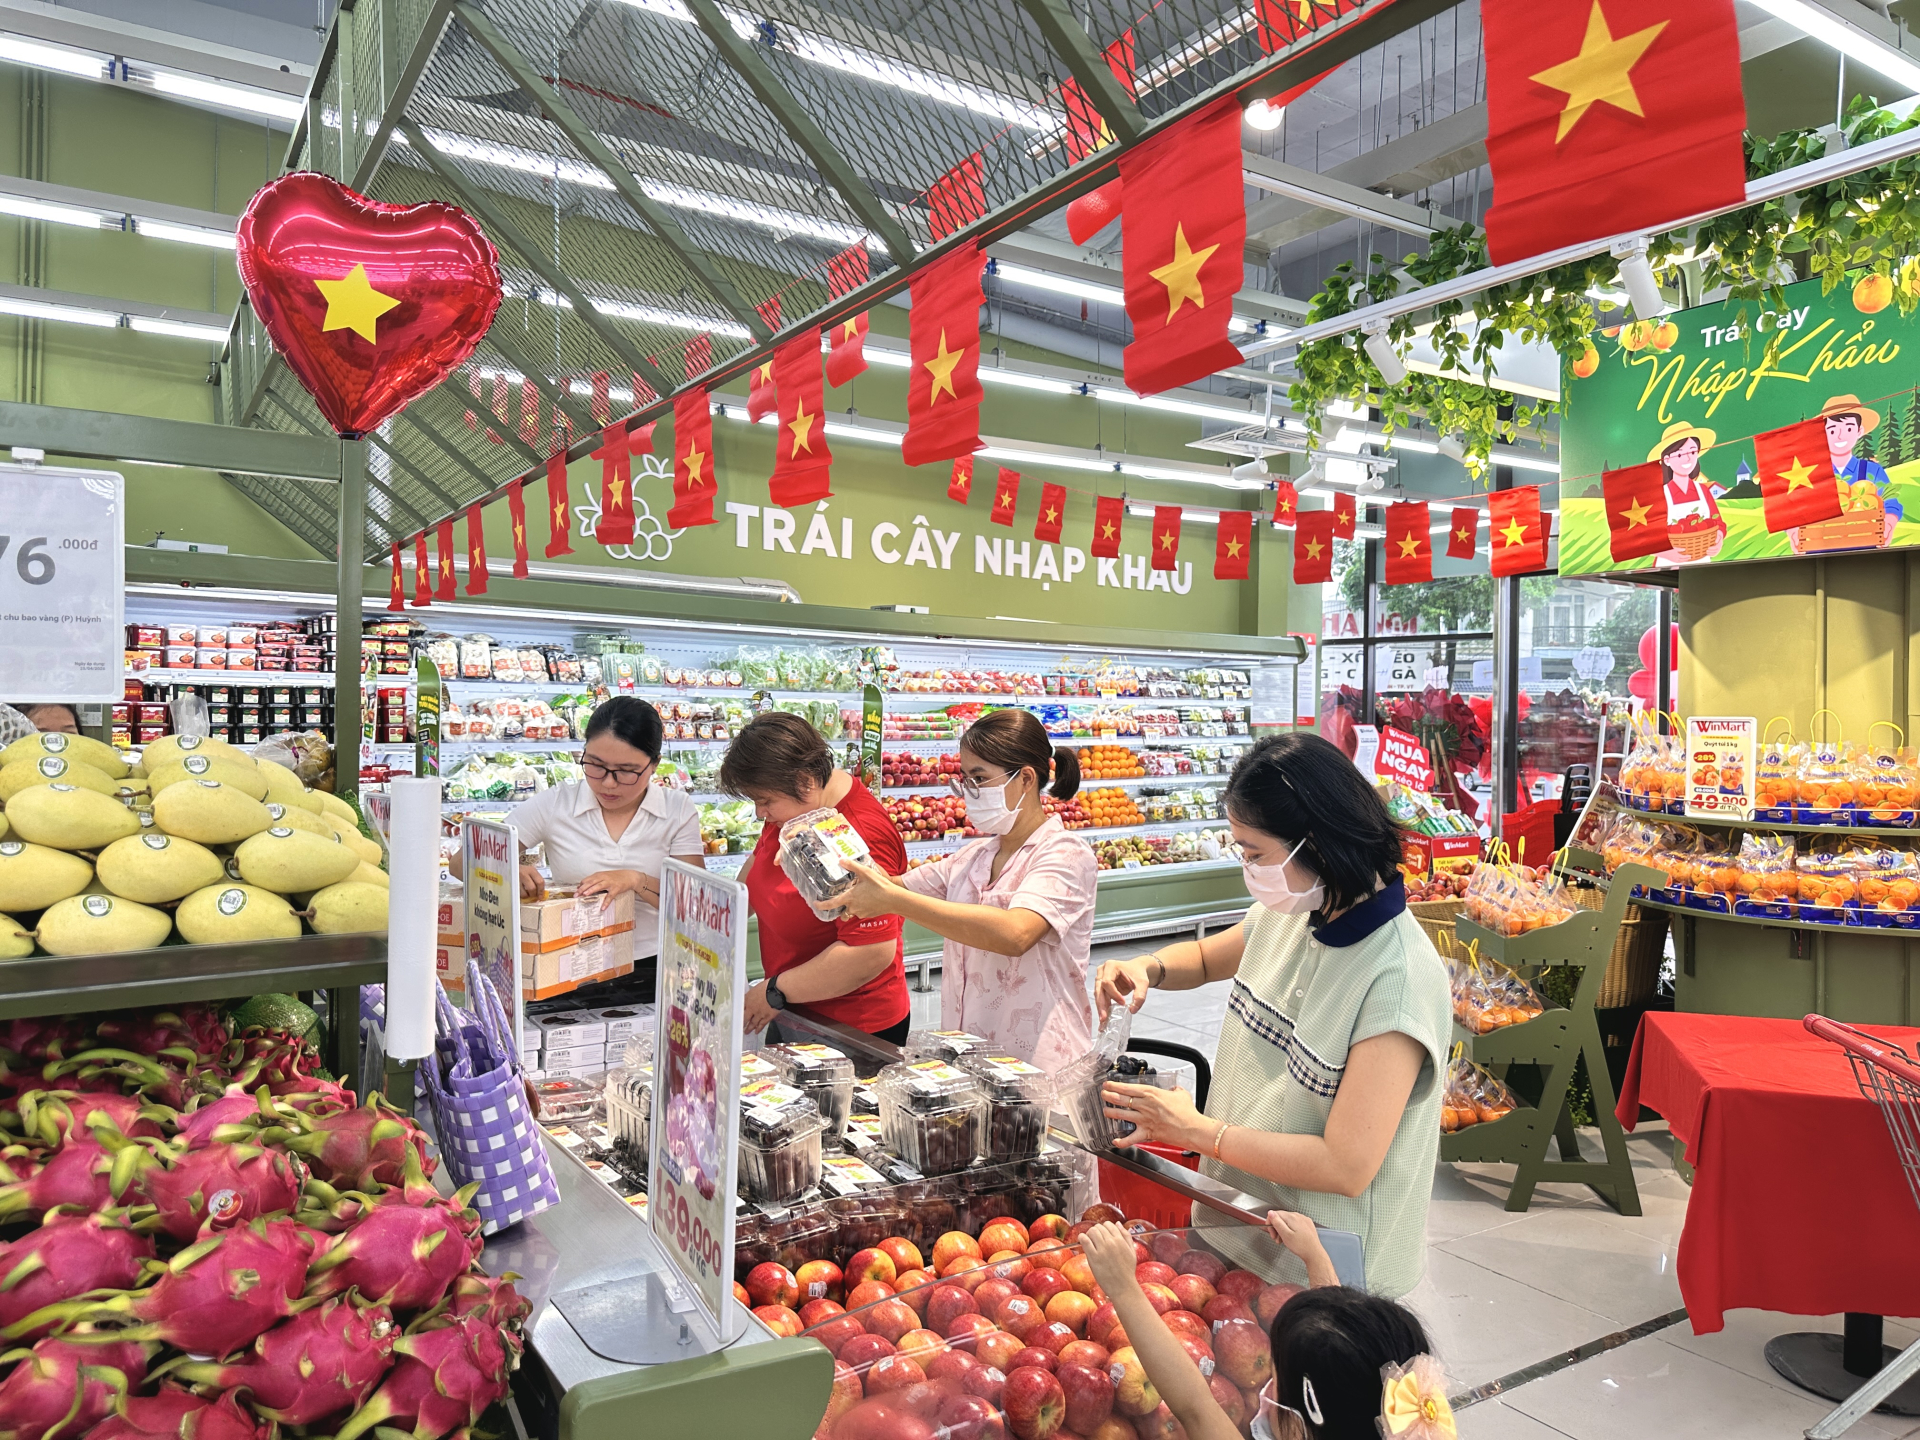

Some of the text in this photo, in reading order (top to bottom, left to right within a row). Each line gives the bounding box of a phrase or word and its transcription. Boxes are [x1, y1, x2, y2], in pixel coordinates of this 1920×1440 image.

[1631, 318, 1900, 424] Nhập Khẩu
[58, 538, 99, 551] .000đ
[725, 500, 853, 560] TRÁI
[870, 515, 961, 570] CÂY
[3, 613, 20, 622] chu
[21, 613, 37, 622] bao
[39, 614, 60, 624] vàng
[61, 615, 74, 624] (P)
[1391, 665, 1417, 680] GÀ
[1388, 728, 1416, 745] WinMart
[1695, 720, 1747, 733] WinMart
[1385, 738, 1426, 764] MUA
[1380, 750, 1431, 782] NGAY
[471, 824, 508, 864] WinMart
[1443, 841, 1470, 851] WinMart
[673, 870, 731, 938] WinMart
[859, 918, 889, 929] MASAN
[655, 1166, 722, 1277] 139.000
